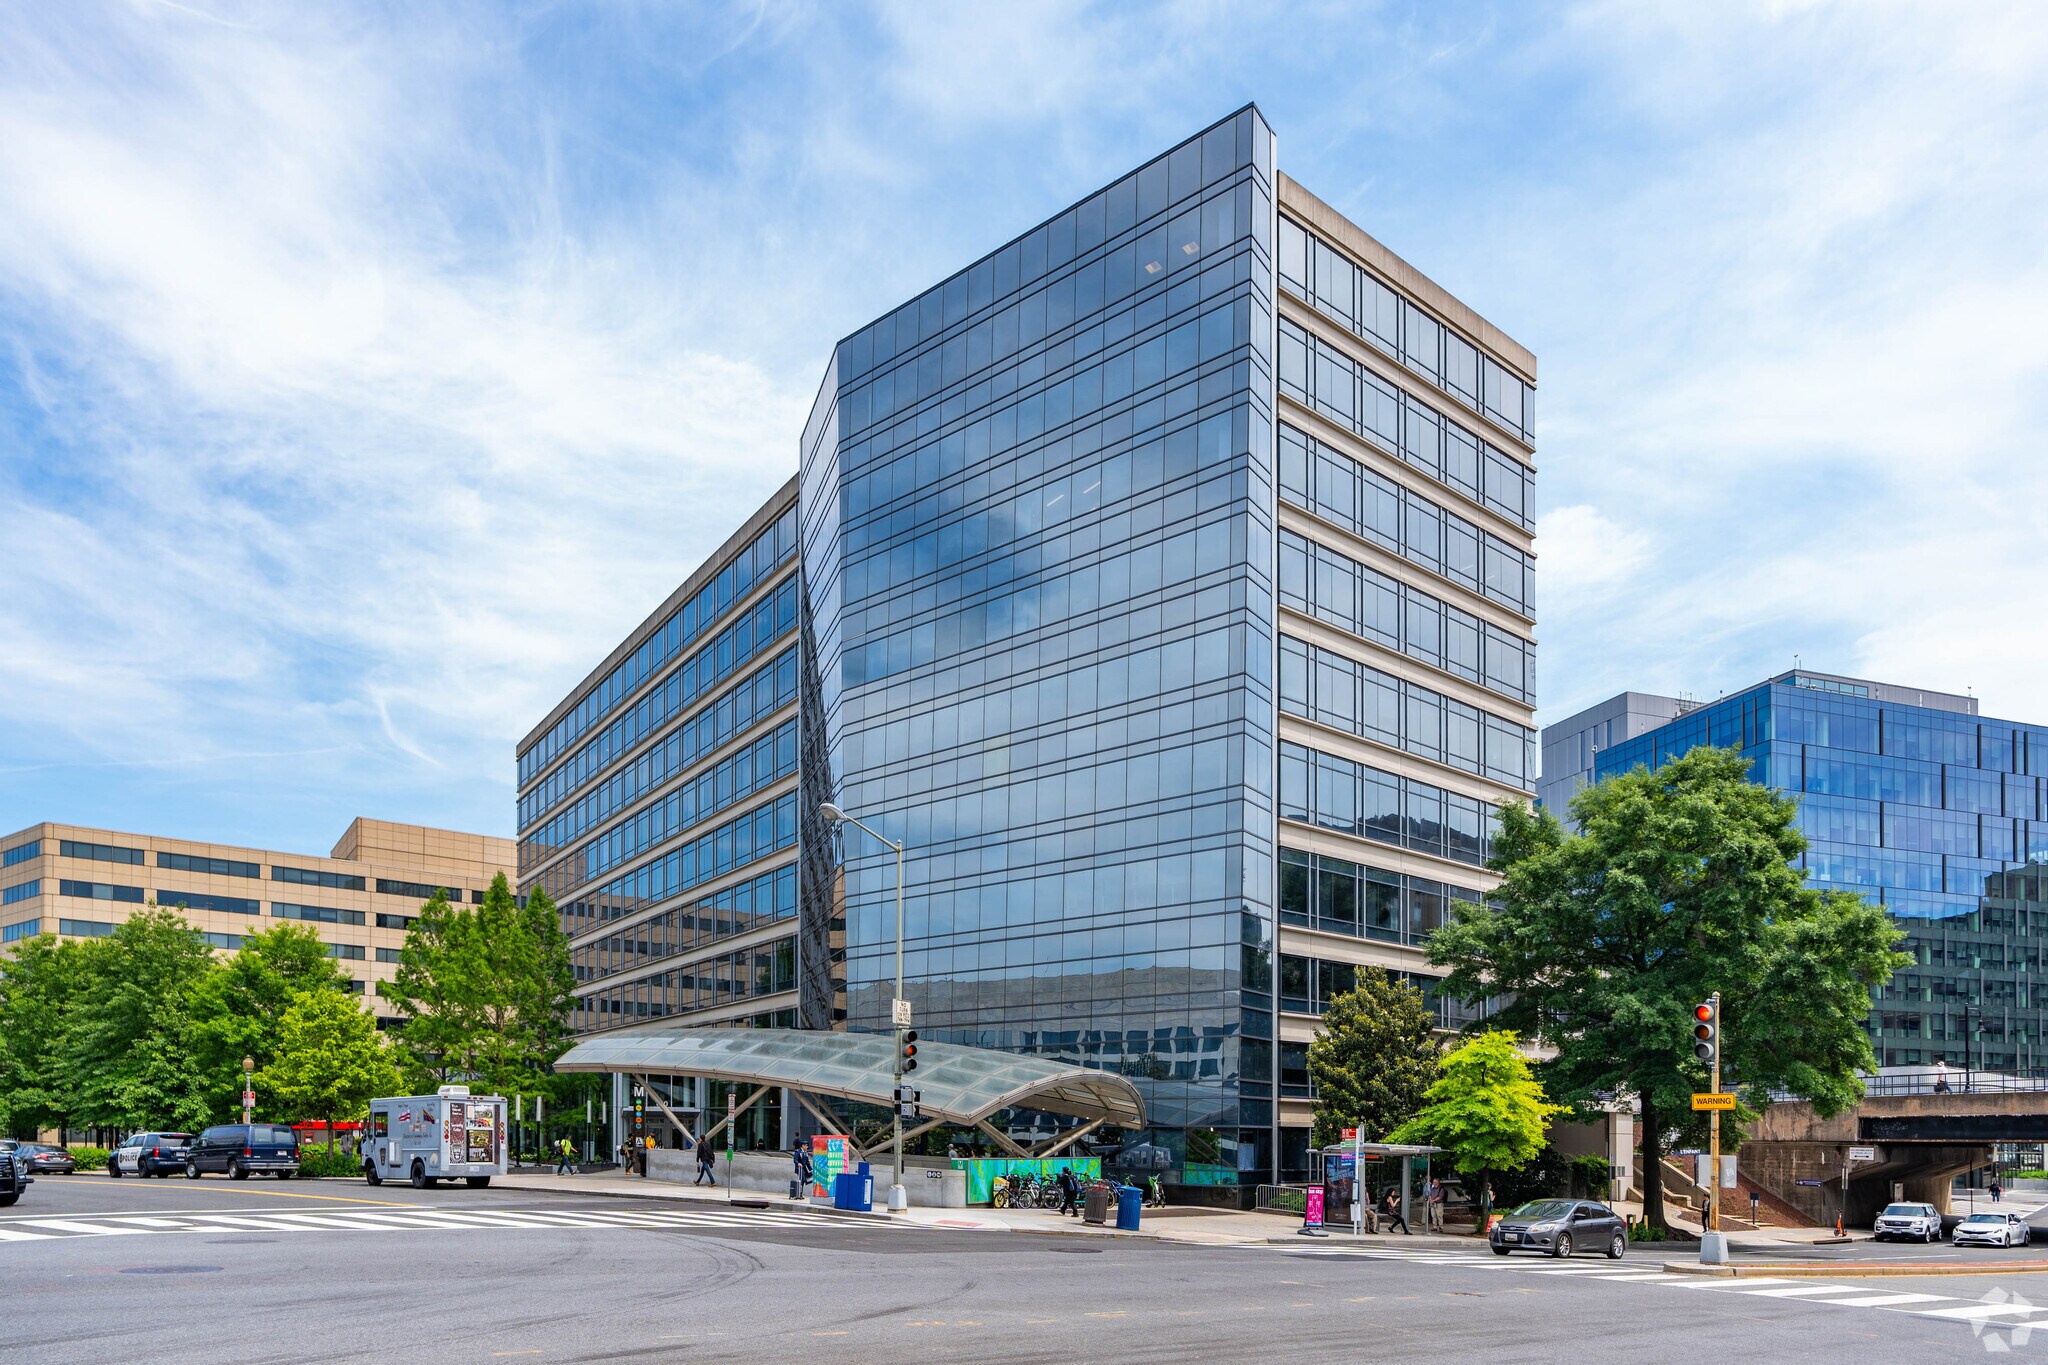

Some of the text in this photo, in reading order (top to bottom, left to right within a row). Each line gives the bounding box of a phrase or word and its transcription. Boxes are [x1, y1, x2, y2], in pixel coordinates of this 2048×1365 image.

[633, 1086, 645, 1097] M
[1696, 1097, 1732, 1105] WARNING
[122, 1154, 138, 1162] POLICE
